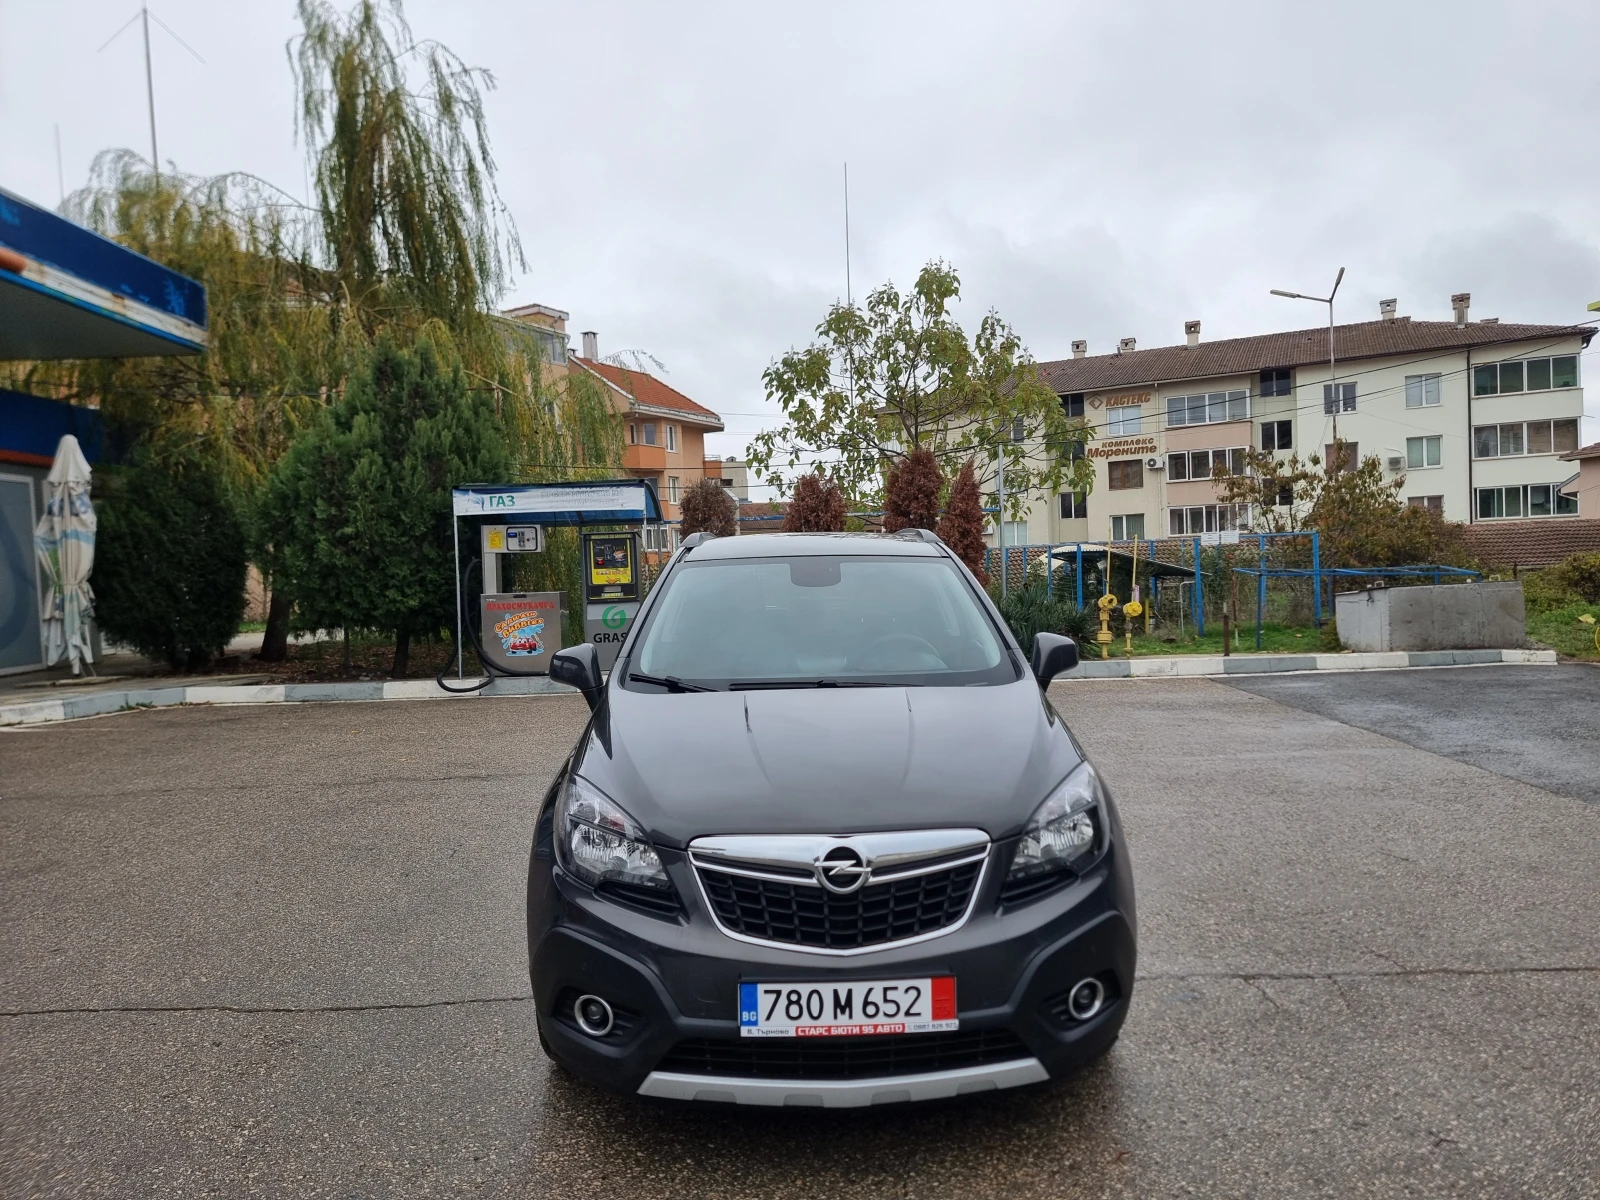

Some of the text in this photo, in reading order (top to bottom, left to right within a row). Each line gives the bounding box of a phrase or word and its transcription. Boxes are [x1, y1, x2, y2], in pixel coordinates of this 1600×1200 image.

[1105, 392, 1152, 407] КАСТЕКС
[1087, 445, 1157, 459] Морените
[489, 495, 516, 508] ГАЗ
[742, 1011, 757, 1022] BG
[797, 1027, 829, 1036] СТАРС
[830, 1026, 861, 1035] БЮТИ
[862, 1025, 875, 1034] 95
[876, 1024, 904, 1034] АВТО
